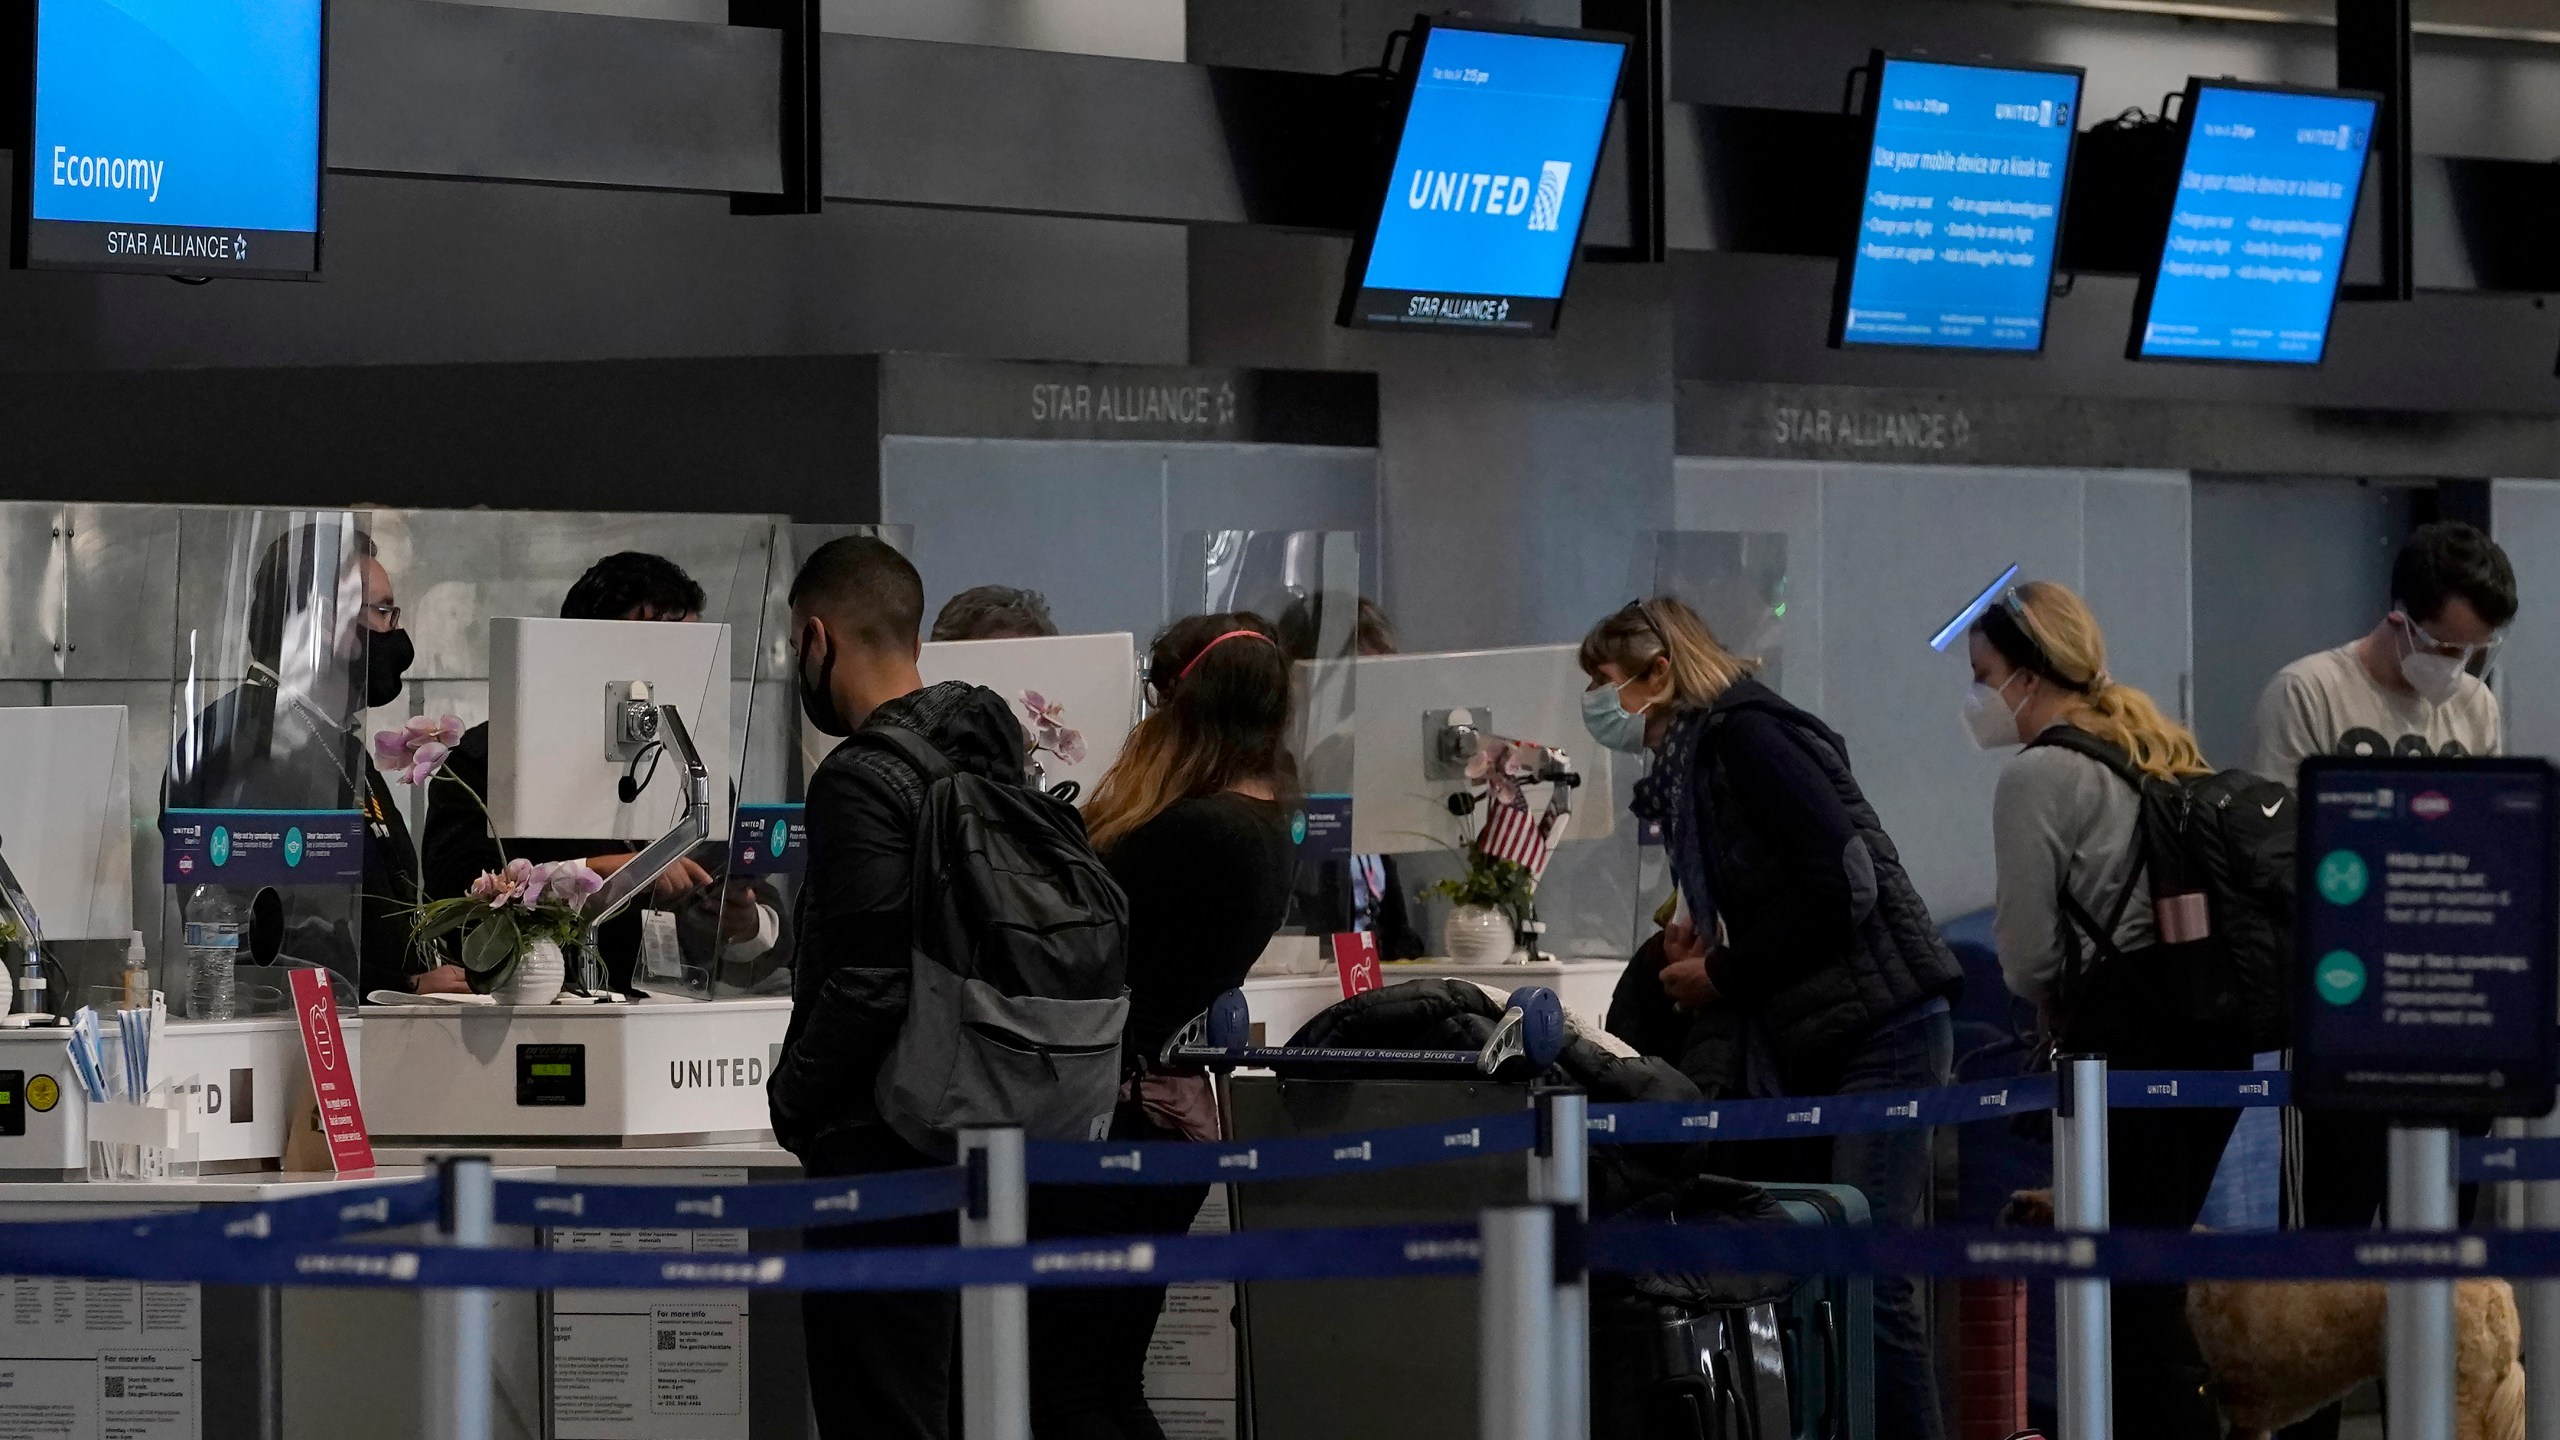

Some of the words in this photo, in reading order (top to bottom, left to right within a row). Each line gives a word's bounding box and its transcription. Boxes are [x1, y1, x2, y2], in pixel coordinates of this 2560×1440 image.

[1995, 103, 2040, 122] UNITED
[53, 145, 164, 203] Economy
[1875, 146, 1895, 168] Use
[1895, 152, 1920, 173] your
[1920, 150, 1955, 171] mobile
[1956, 152, 1987, 174] device
[1989, 158, 2001, 174] or
[2010, 155, 2036, 177] kiosk
[1408, 169, 1531, 216] UNITED
[108, 232, 148, 254] STAR
[152, 234, 229, 259] ALLIANCE
[1408, 296, 1440, 317] STAR
[1439, 297, 1498, 320] ALLIANCE
[1032, 383, 1091, 422] STAR
[1097, 385, 1210, 424] ALLIANCE
[1775, 407, 1833, 444] STAR
[1838, 413, 1946, 449] ALLIANCE
[173, 827, 194, 835] UNITED
[671, 1057, 762, 1089] UNITED
[2147, 1085, 2171, 1096] UNITED
[2239, 1085, 2262, 1095] UNITED
[105, 1355, 116, 1363] For
[141, 1355, 156, 1363] info
